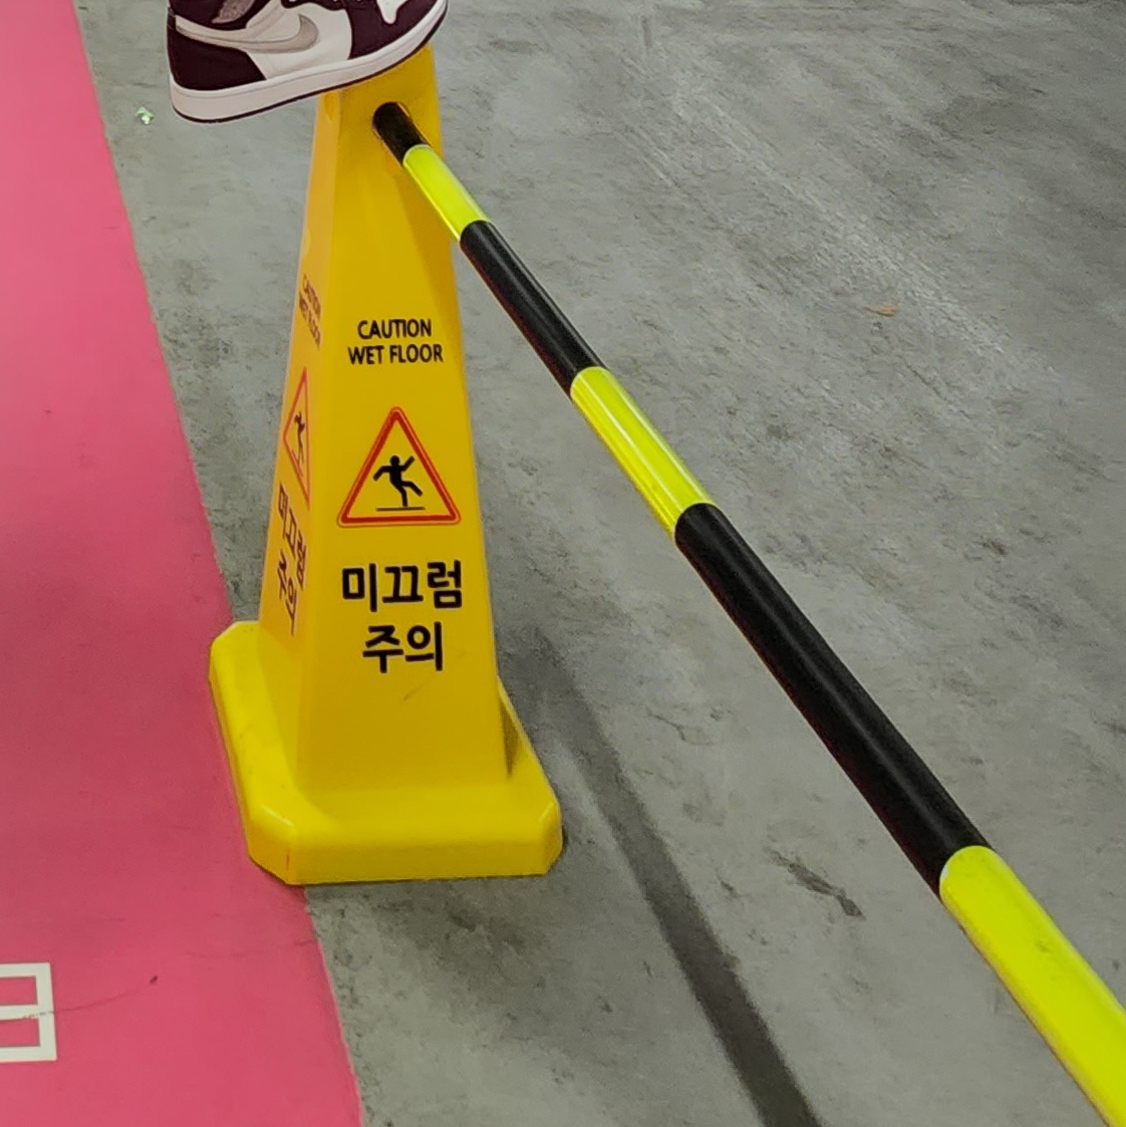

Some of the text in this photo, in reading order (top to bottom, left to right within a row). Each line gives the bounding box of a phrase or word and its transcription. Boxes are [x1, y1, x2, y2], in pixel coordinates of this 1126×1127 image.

[357, 318, 432, 340] CAUTION
[347, 343, 443, 365] WET FLOOR
[341, 560, 463, 612] 미끄럼
[362, 621, 443, 674] 주의
